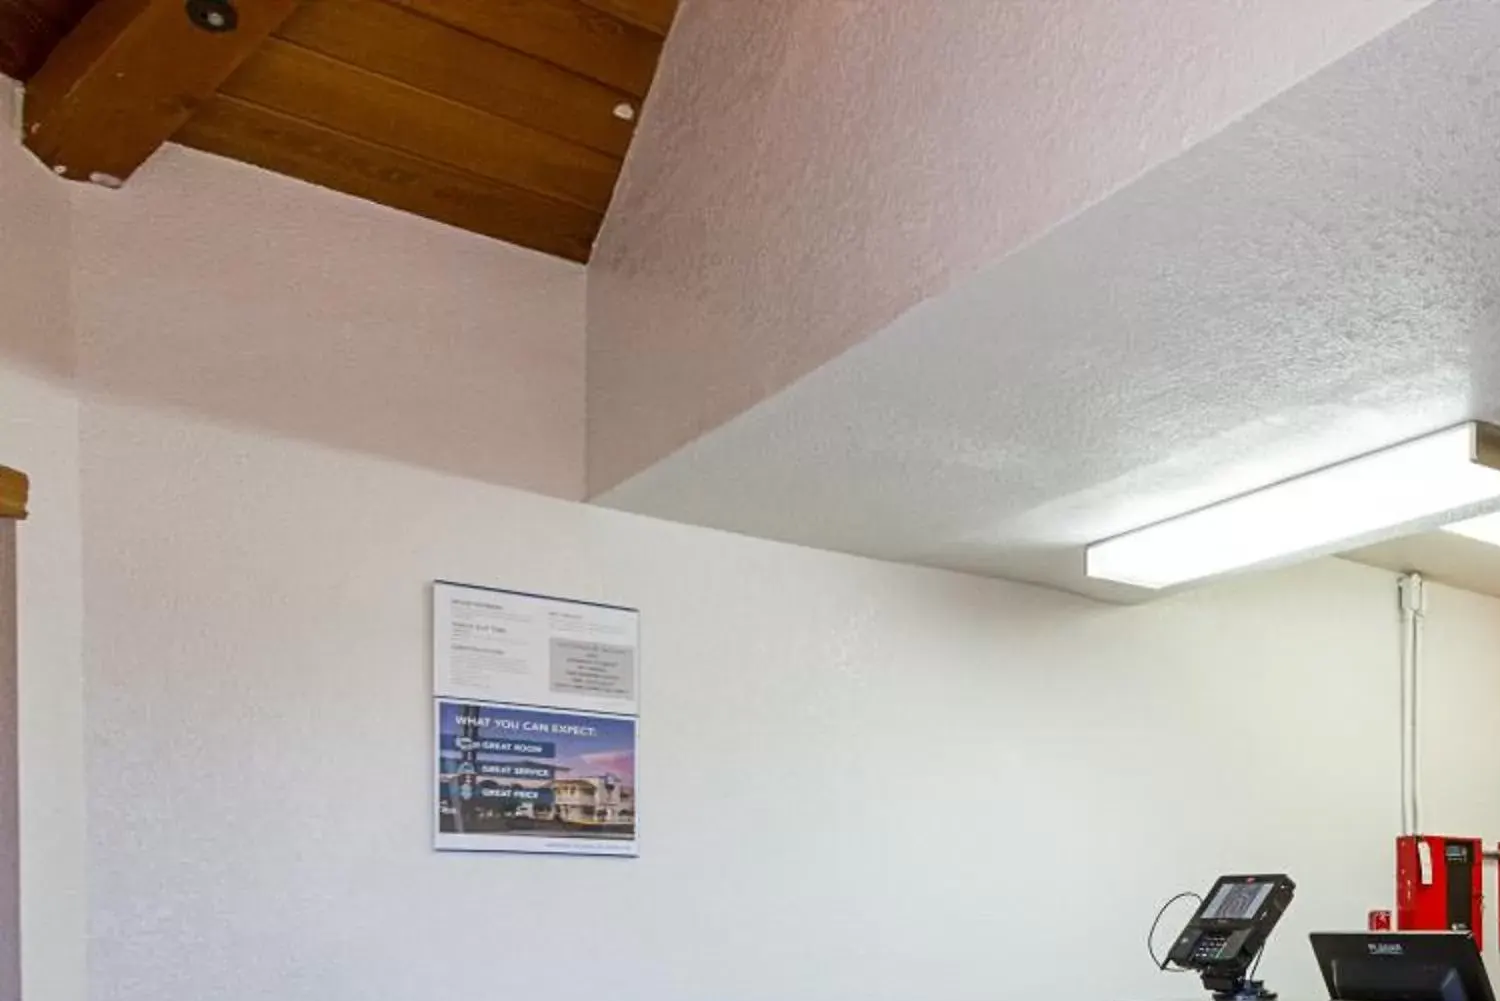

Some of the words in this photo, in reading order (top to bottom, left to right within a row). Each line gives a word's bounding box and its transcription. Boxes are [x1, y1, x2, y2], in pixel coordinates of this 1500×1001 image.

[455, 716, 490, 727] WHAT
[495, 719, 519, 731] YOU
[523, 721, 549, 733] CAN
